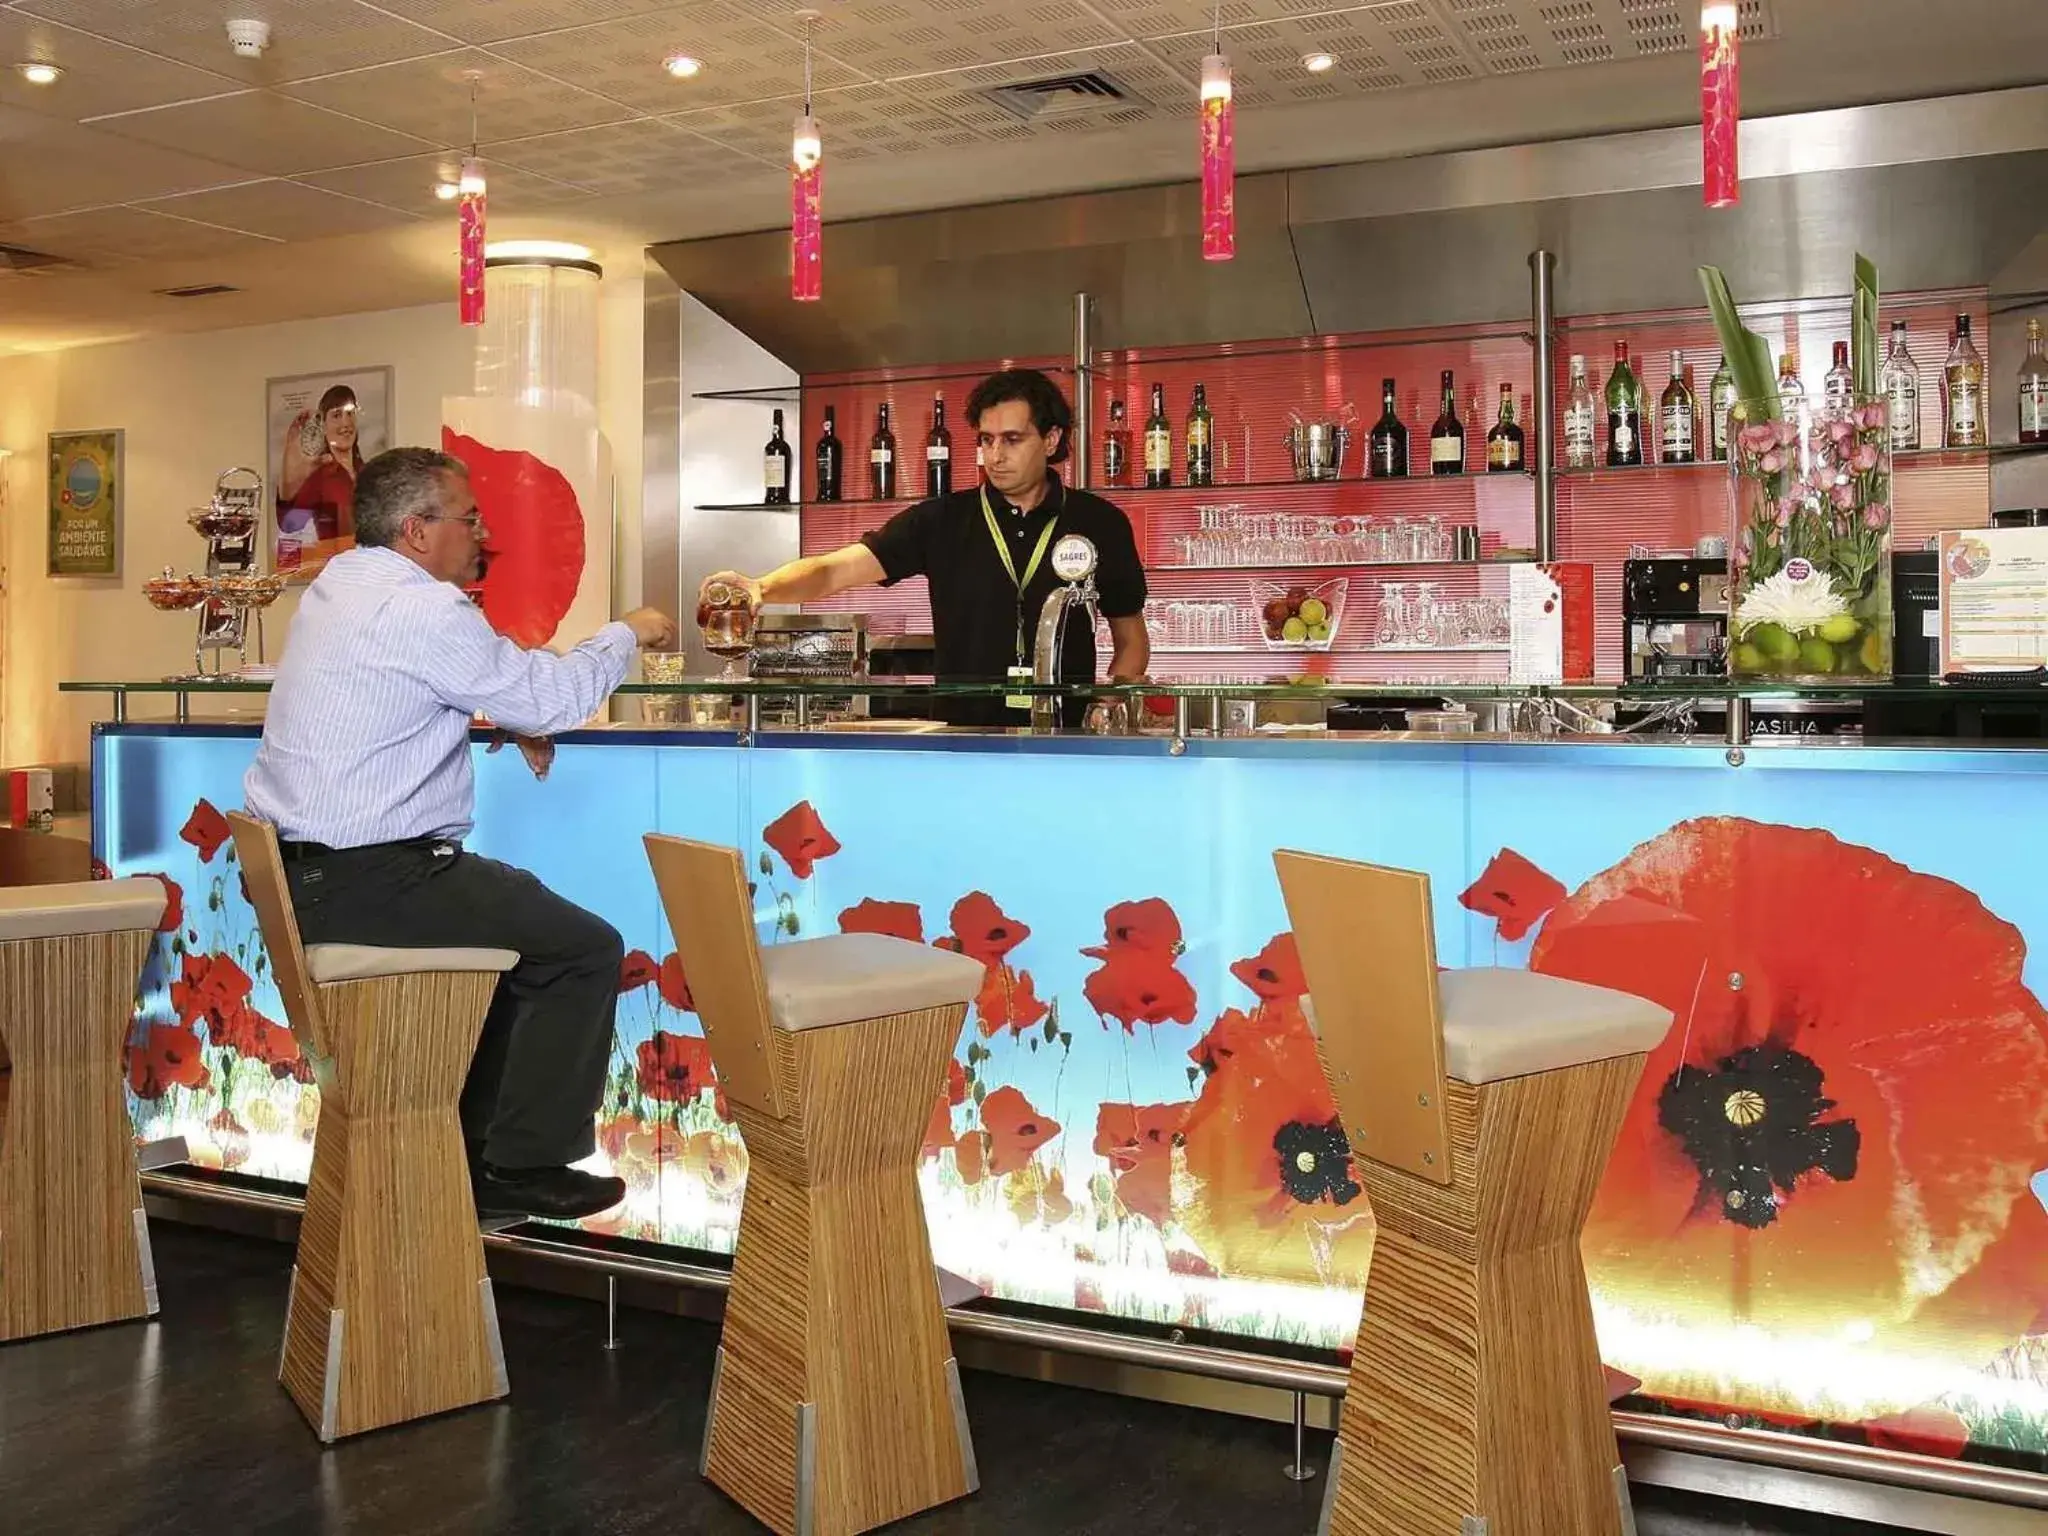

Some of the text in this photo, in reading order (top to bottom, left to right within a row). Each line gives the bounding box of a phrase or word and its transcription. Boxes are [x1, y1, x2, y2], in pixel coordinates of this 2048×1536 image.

[59, 530, 107, 543] AMBIENTE
[1059, 552, 1088, 561] SAGRES
[1749, 719, 1818, 734] ASILIA
